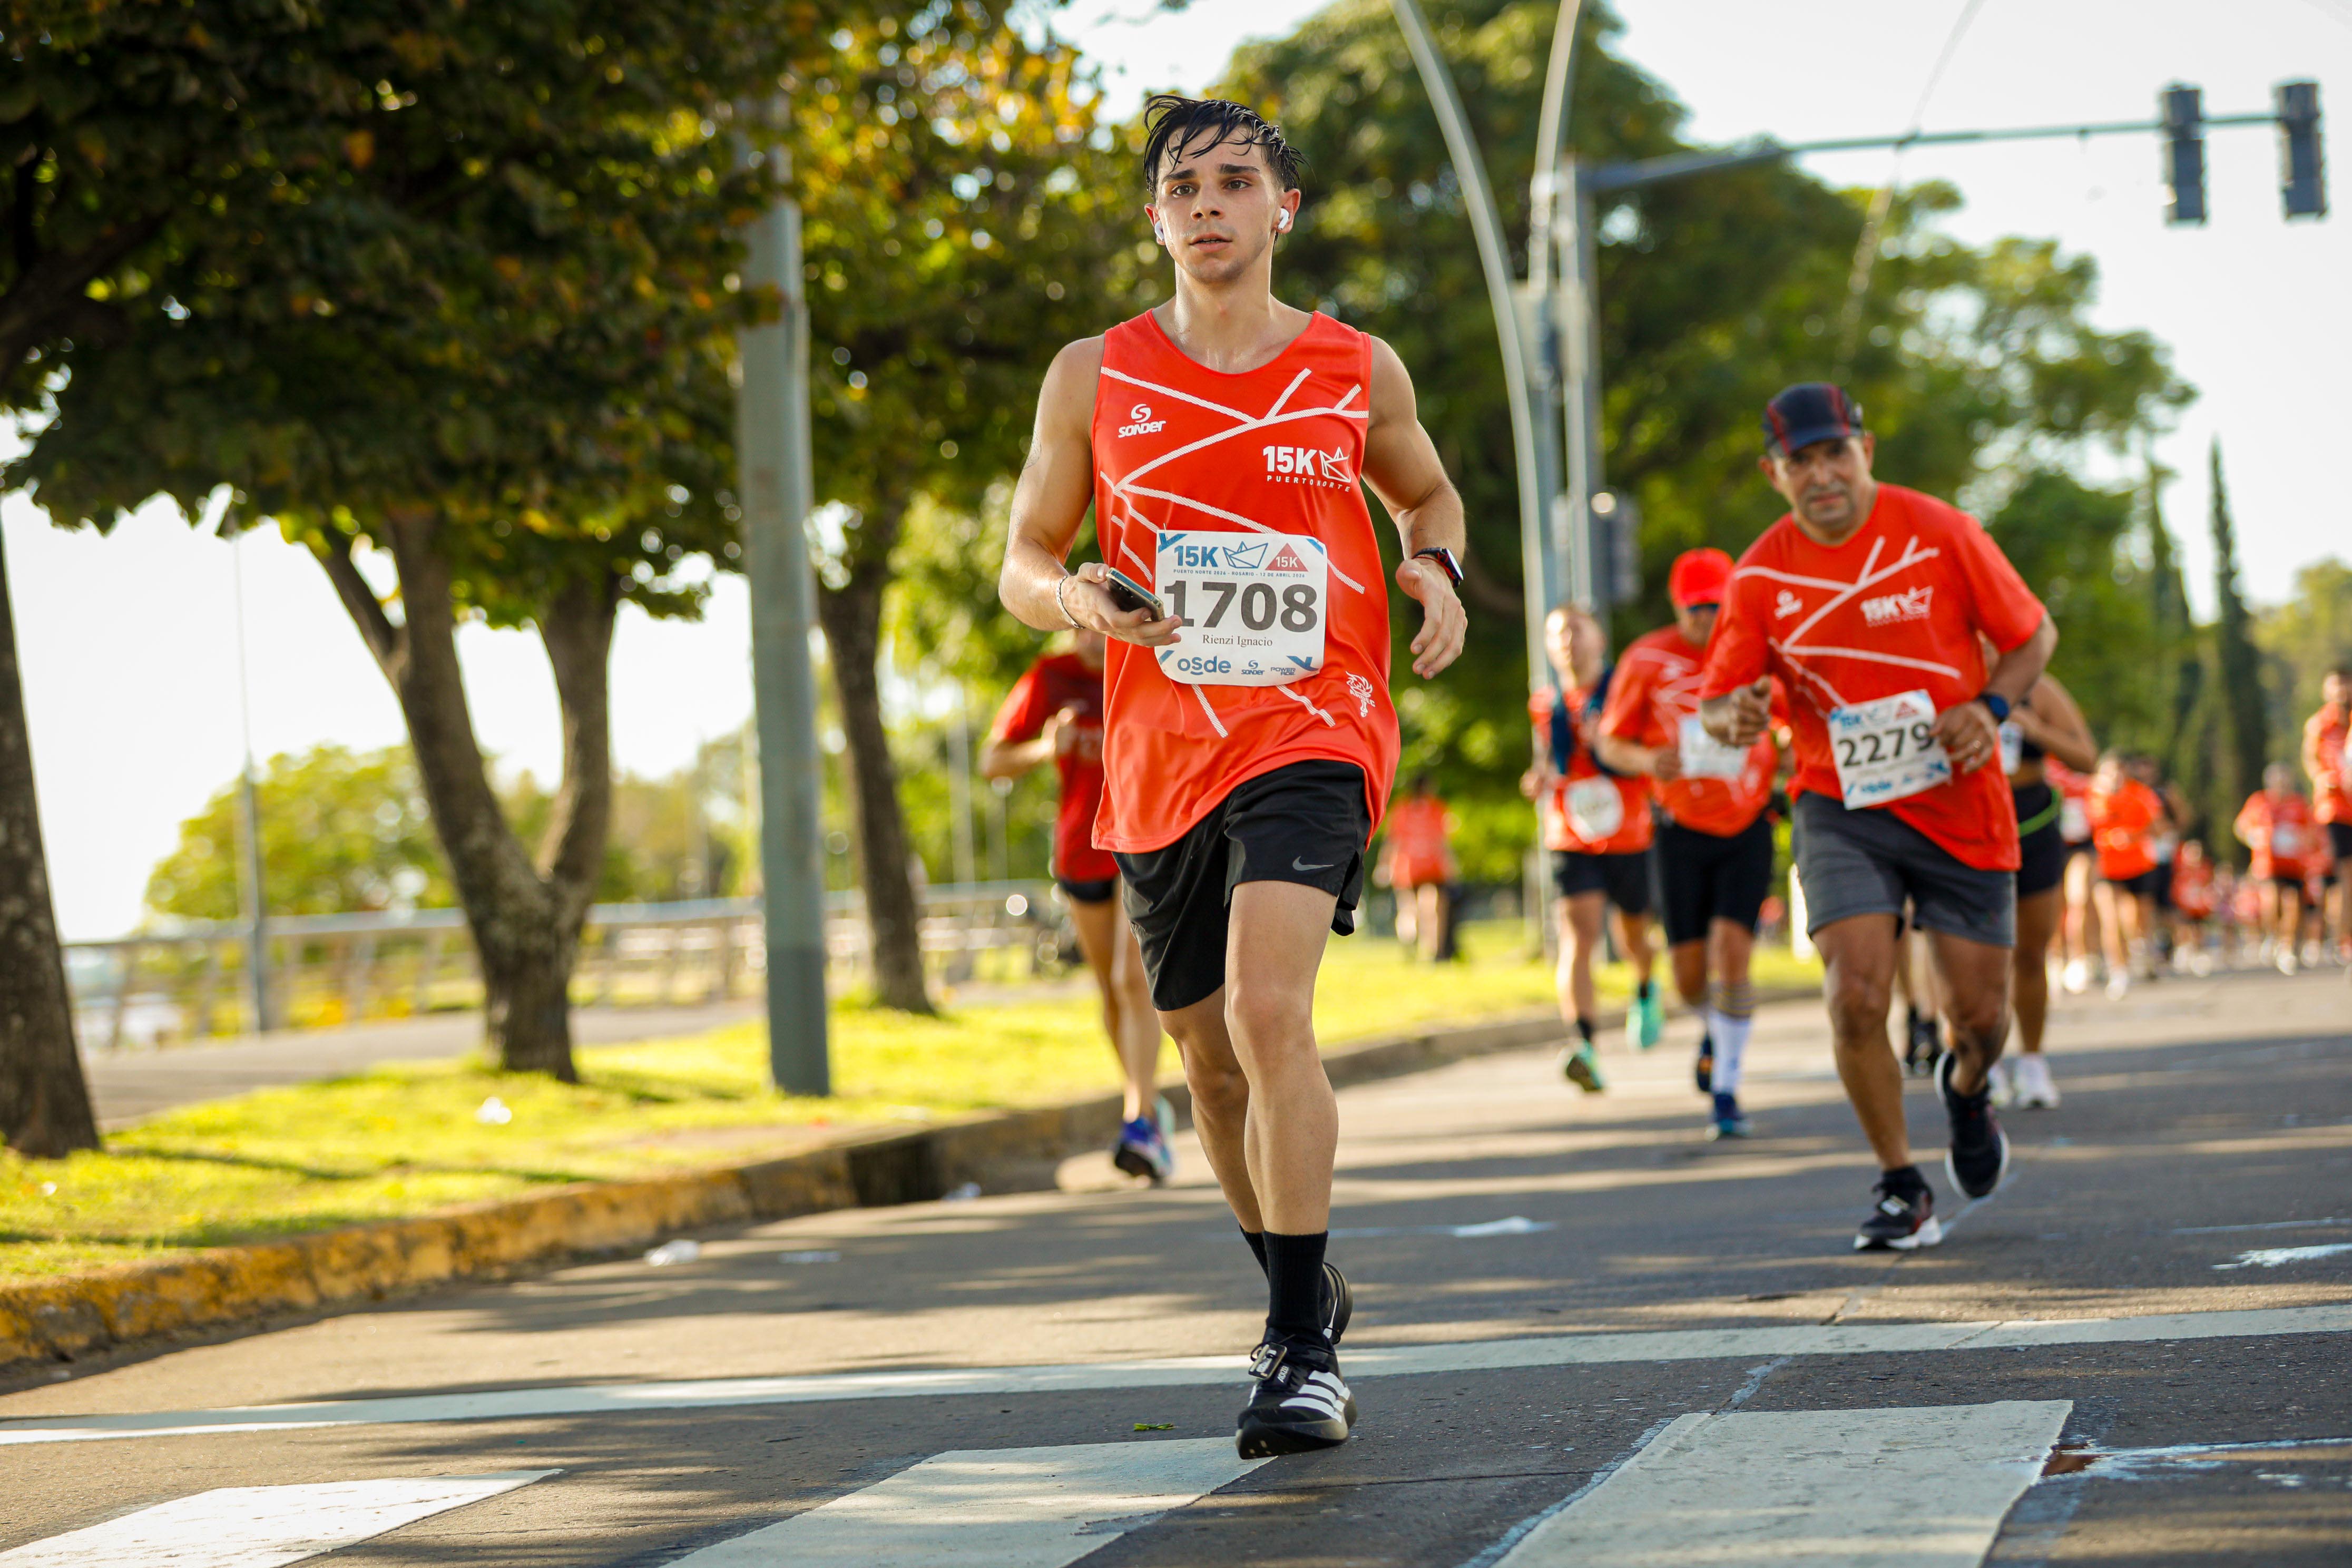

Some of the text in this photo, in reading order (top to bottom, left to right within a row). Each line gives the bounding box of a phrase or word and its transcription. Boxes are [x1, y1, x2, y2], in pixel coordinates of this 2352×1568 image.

[1263, 446, 1317, 476] 15K
[1267, 475, 1350, 492] PUERTO NORTE
[1174, 545, 1219, 567] 15K
[1276, 556, 1298, 568] 15K
[1164, 580, 1318, 633] 1708
[1202, 634, 1273, 648] Rienzi Ignacio
[1177, 655, 1231, 674] osde
[1837, 720, 1935, 767] 2279
